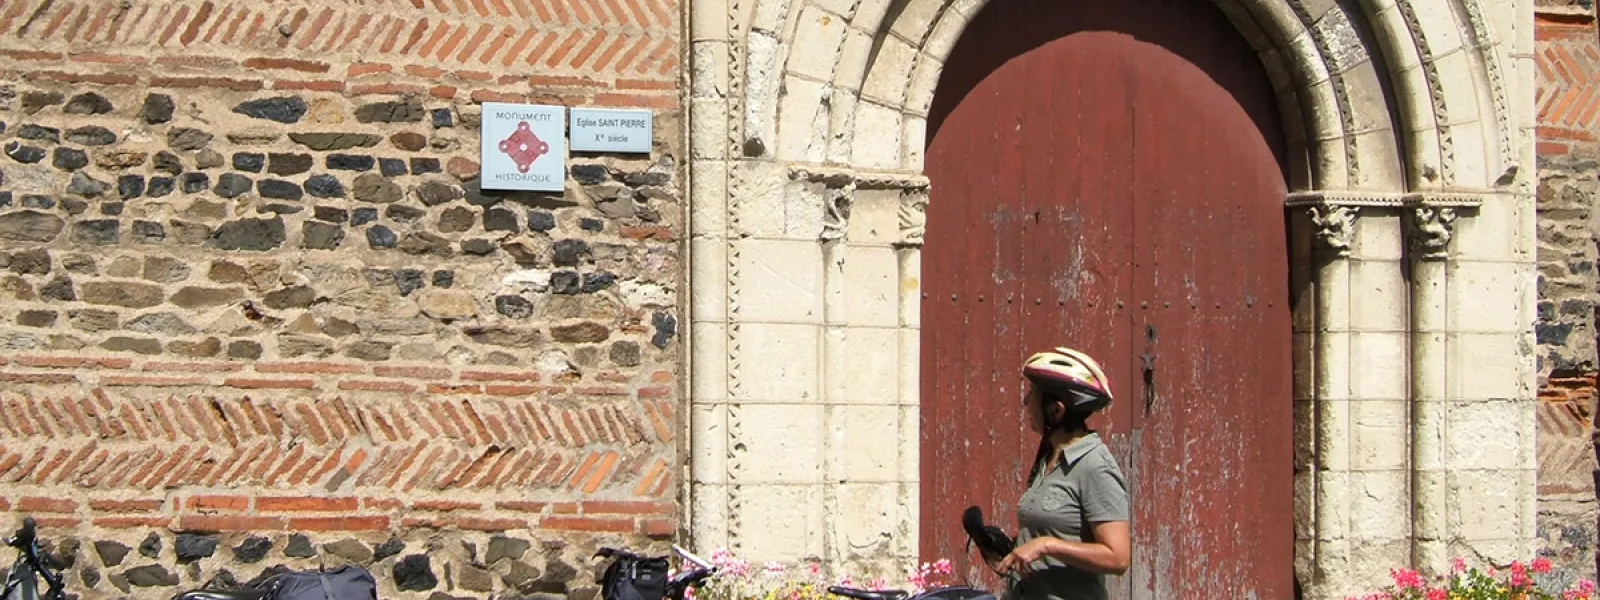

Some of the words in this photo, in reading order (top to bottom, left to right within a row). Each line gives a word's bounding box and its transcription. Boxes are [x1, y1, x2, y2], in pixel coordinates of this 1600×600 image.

[496, 112, 551, 121] MONUMENT
[577, 118, 598, 129] Eglise
[599, 118, 618, 128] SAINT
[620, 119, 646, 129] PIERRE
[608, 134, 629, 143] siècle
[496, 173, 550, 183] HISTORIQUE
